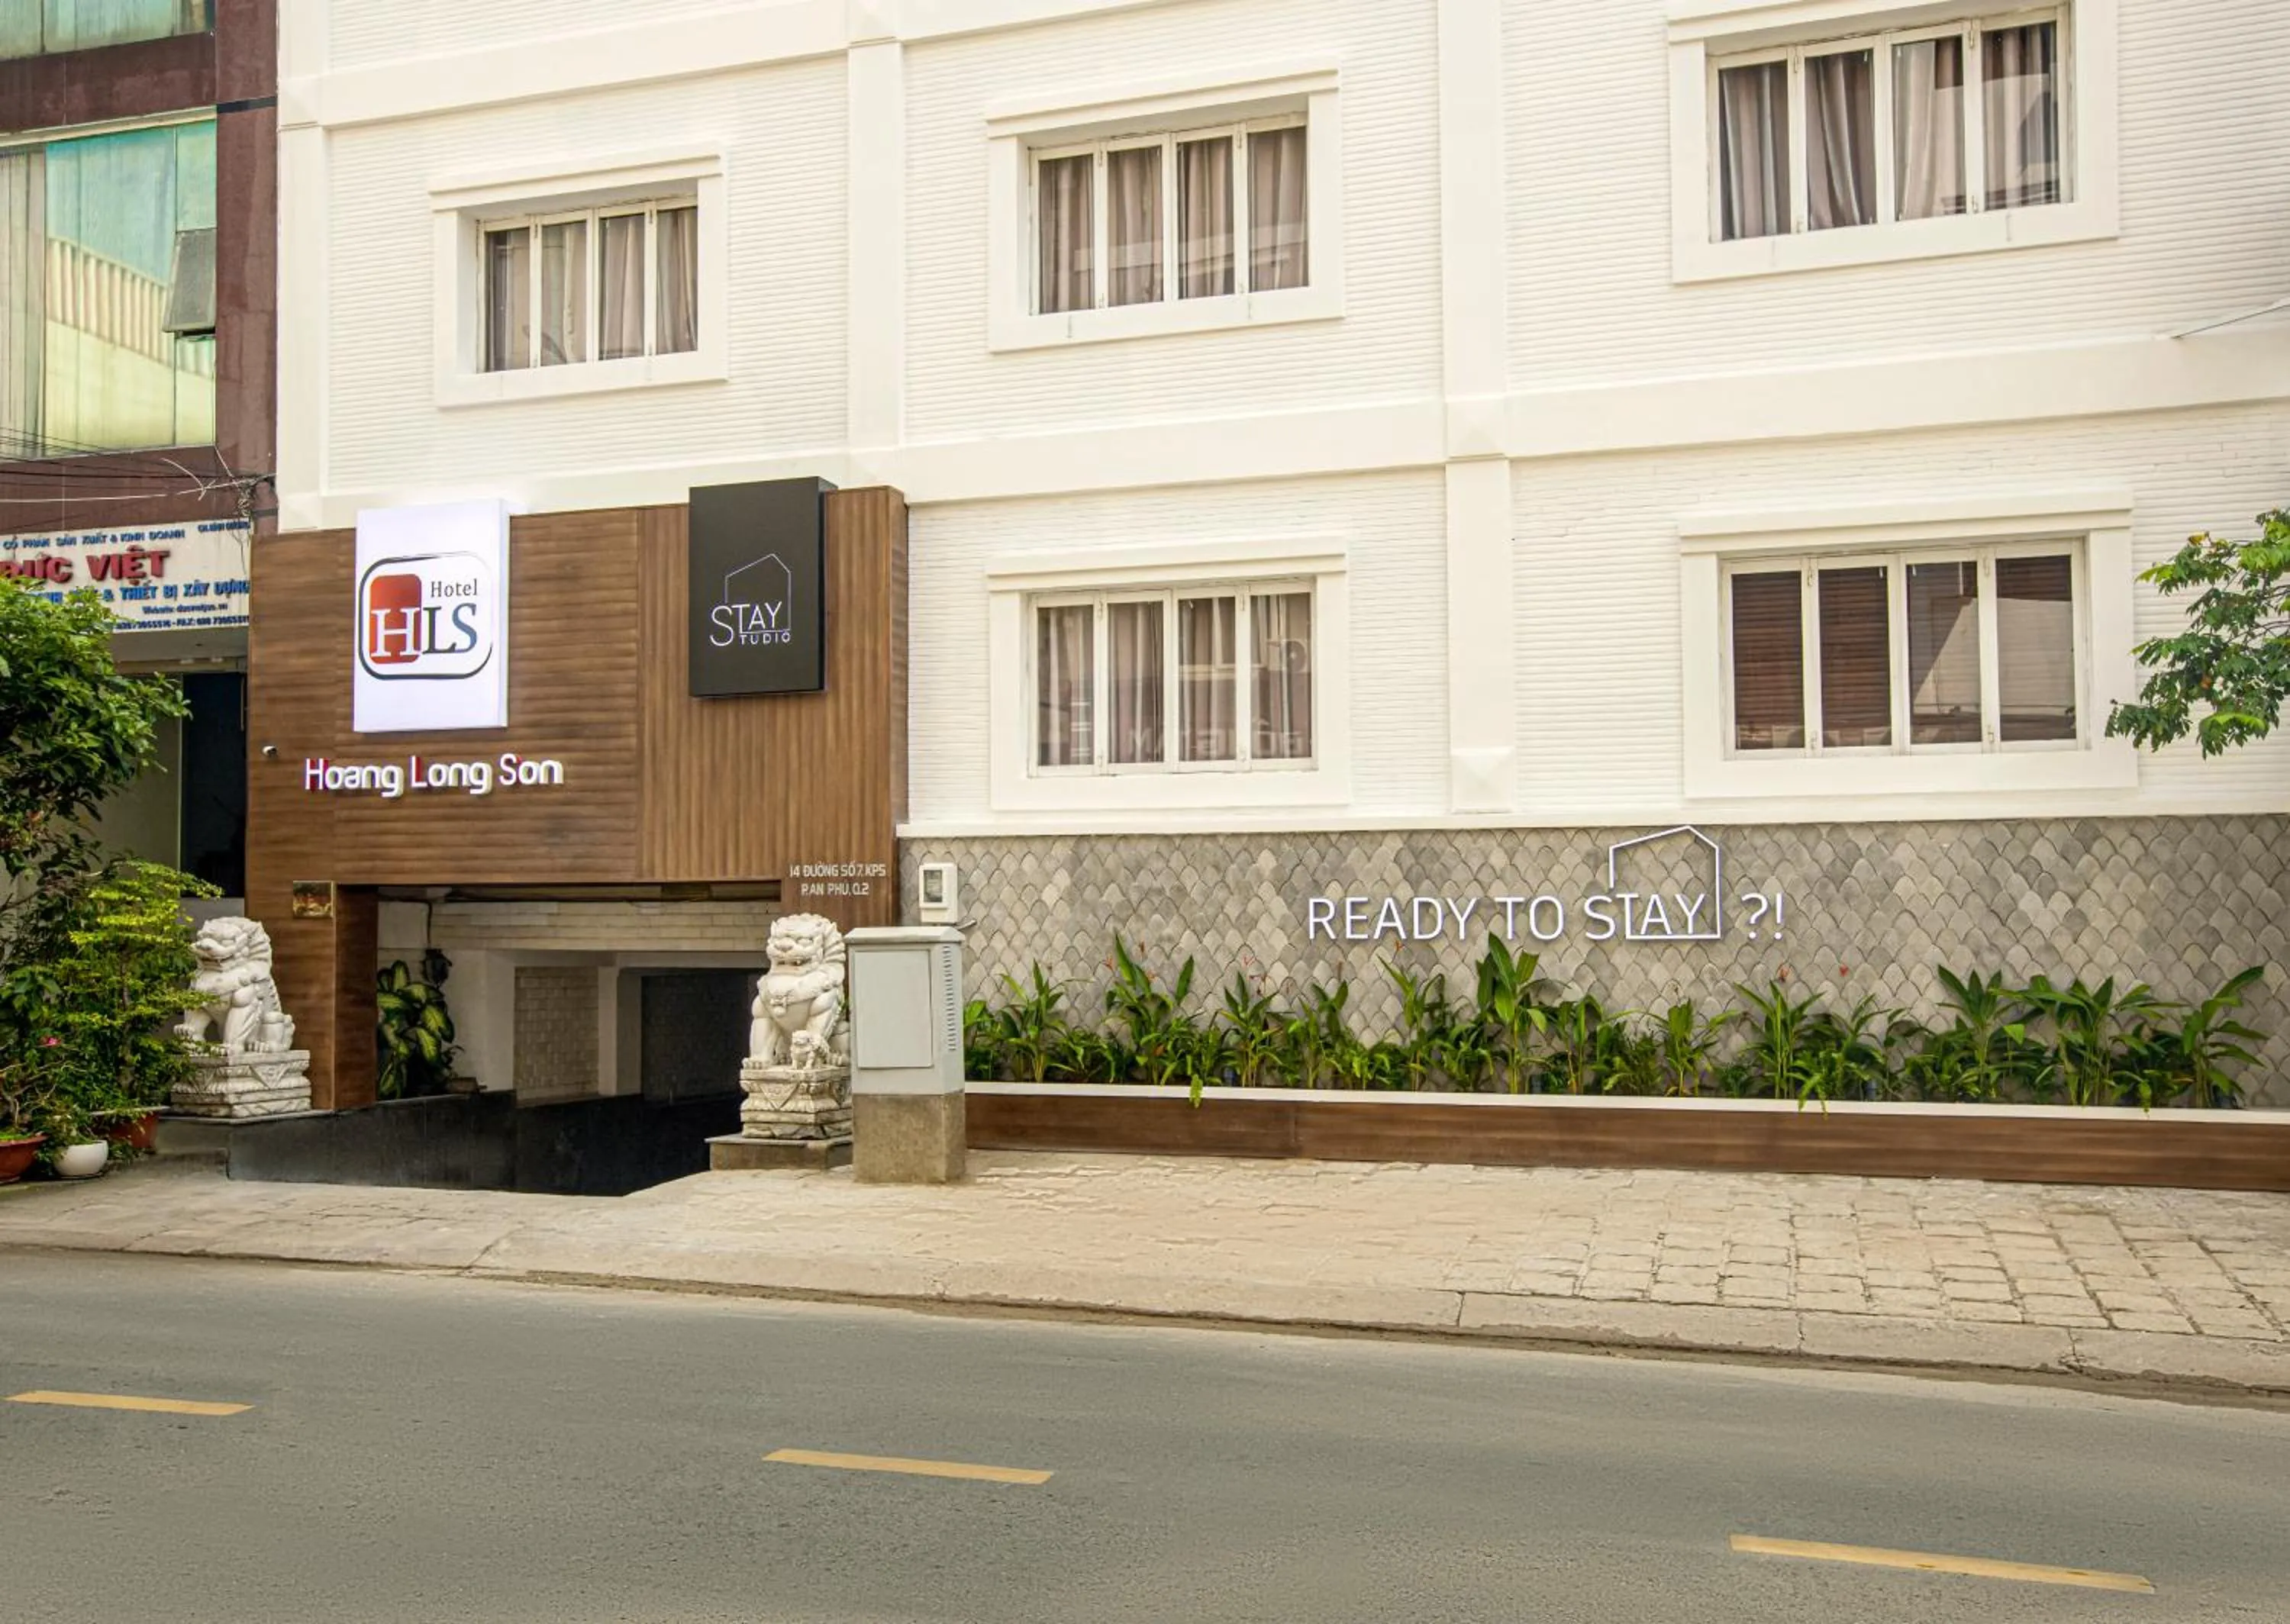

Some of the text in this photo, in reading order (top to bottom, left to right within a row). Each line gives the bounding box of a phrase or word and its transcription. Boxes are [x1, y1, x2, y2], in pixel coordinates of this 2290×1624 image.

[85, 544, 169, 585] VIỆT
[431, 578, 478, 598] Hotel
[371, 603, 477, 657] HLS
[305, 757, 402, 798] Hoang
[411, 756, 492, 794] Long
[789, 865, 800, 878] 14
[1308, 892, 1785, 941] READY TO STAY ?!
